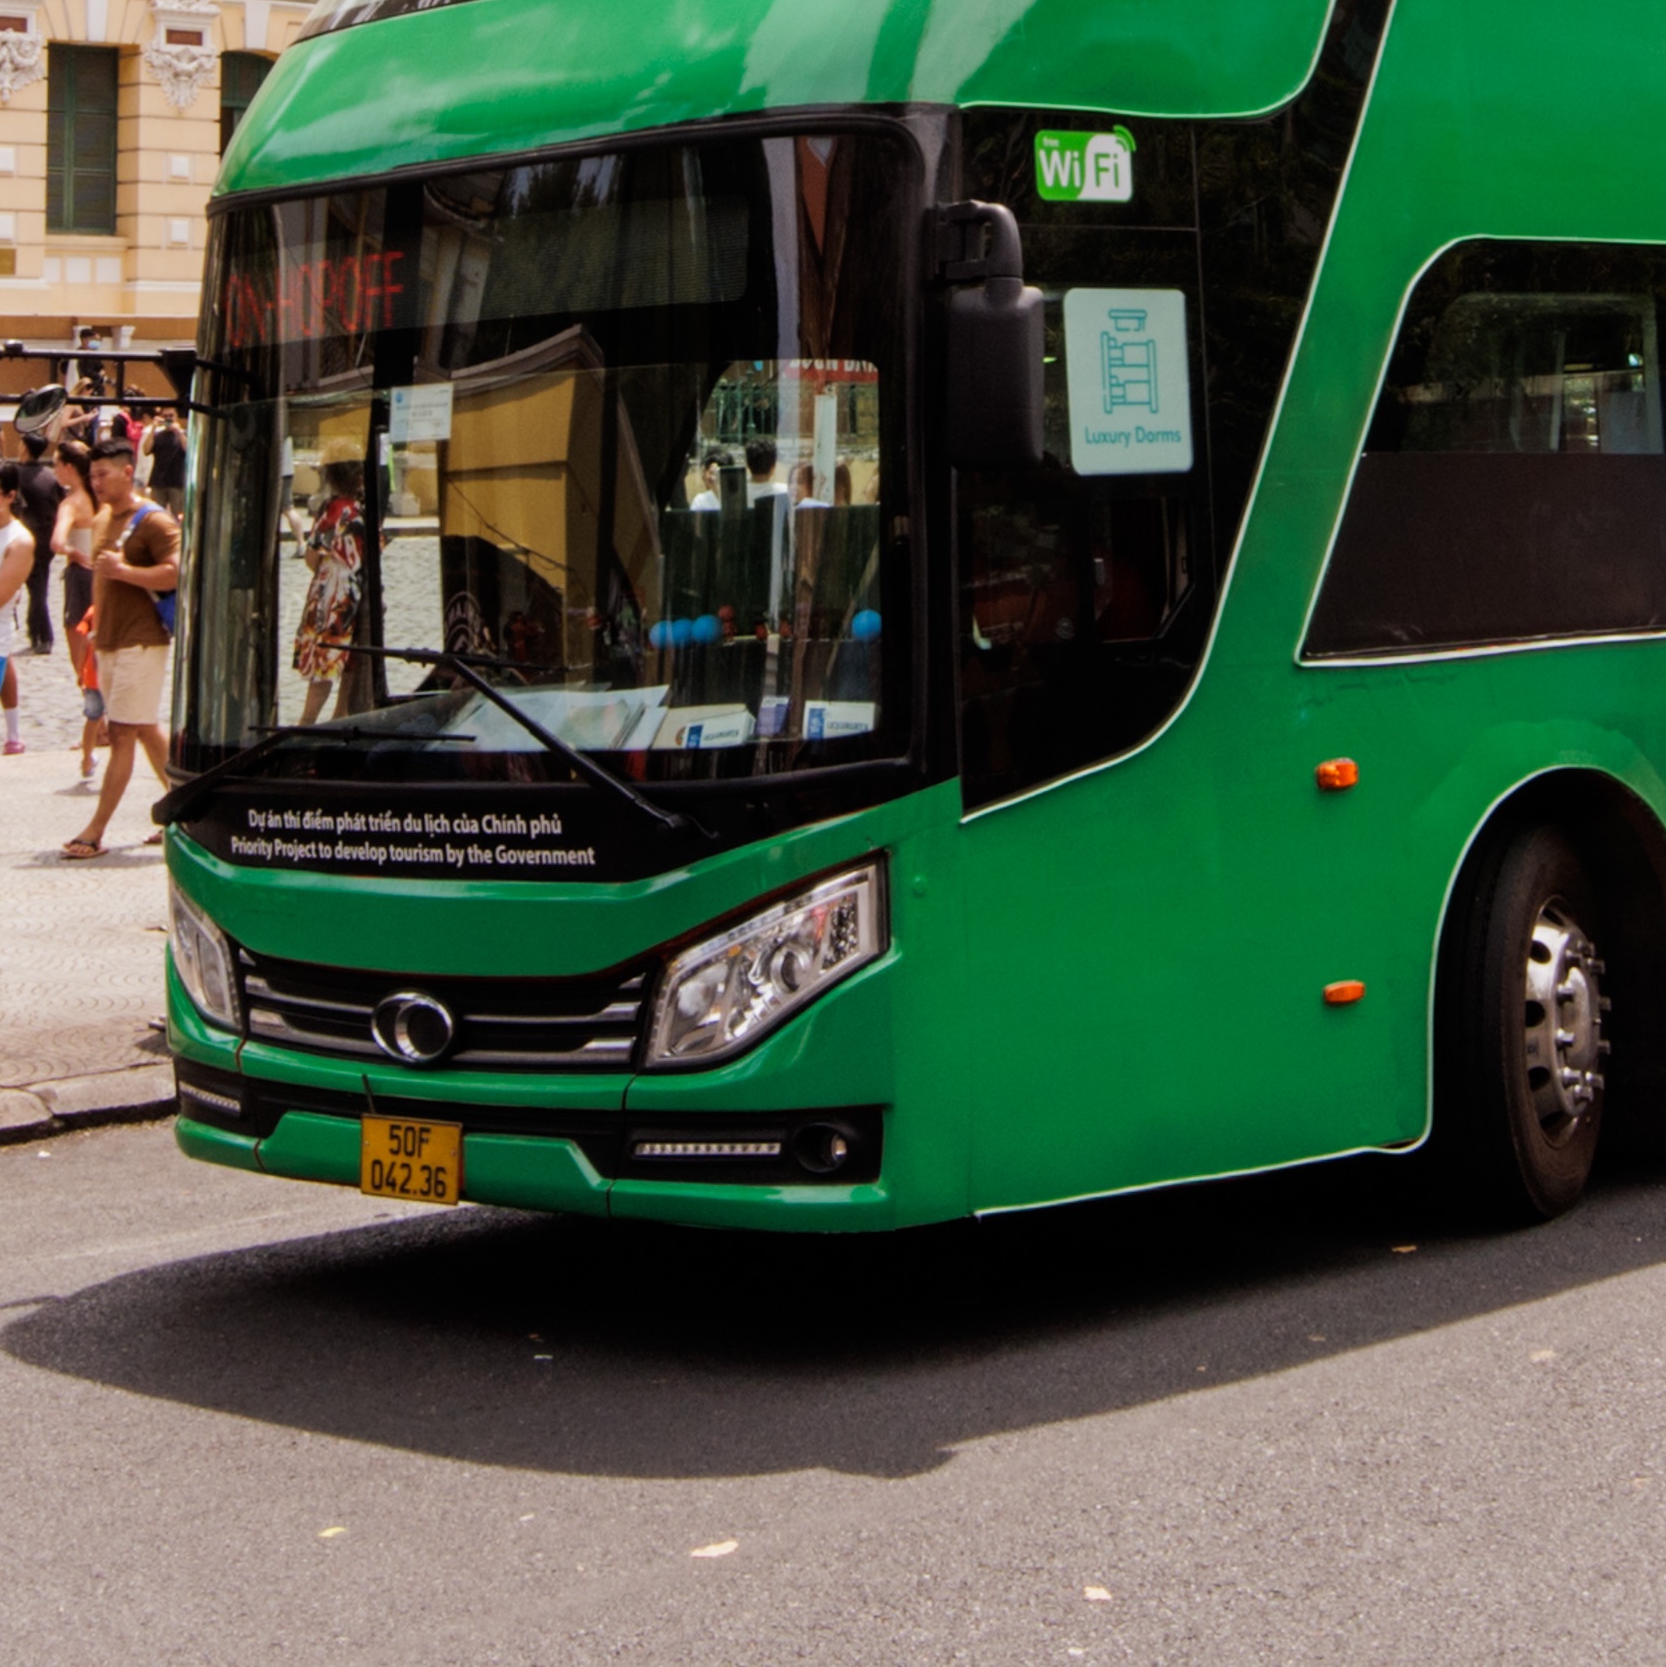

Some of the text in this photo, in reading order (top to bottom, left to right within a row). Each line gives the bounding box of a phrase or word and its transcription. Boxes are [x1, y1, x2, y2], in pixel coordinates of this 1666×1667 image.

[1042, 136, 1060, 148] free
[1084, 426, 1182, 448] Luxury Dorms
[248, 808, 562, 839] Dự án thí điểm phát triển du lịch của Chính phủ
[231, 836, 596, 868] Priority Project to develop tourism by the Government
[389, 1124, 431, 1158] 50F
[371, 1159, 447, 1198] 042.36
